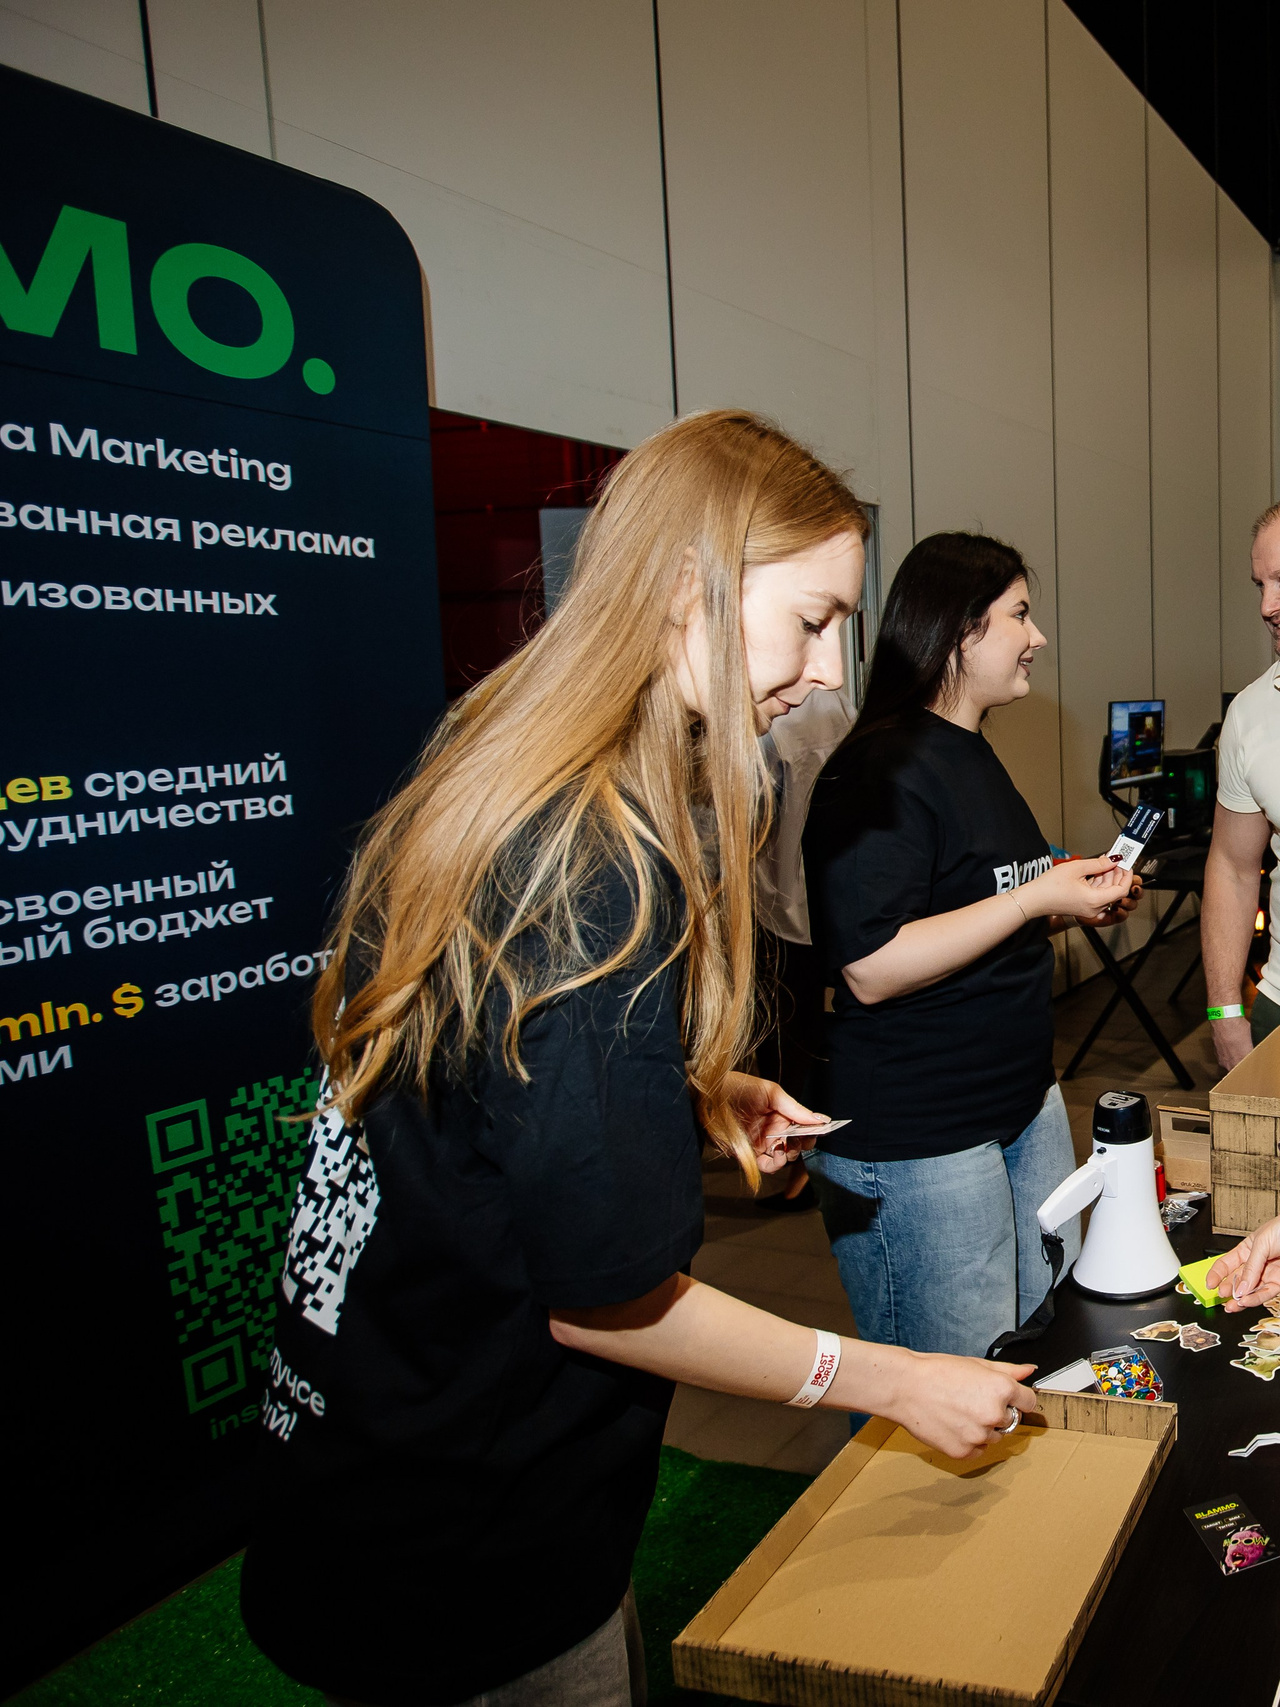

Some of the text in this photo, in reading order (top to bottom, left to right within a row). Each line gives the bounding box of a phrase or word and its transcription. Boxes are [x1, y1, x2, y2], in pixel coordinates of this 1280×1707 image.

[49, 422, 292, 491] Marketing
[192, 519, 376, 559] реклама
[0, 580, 279, 617] изованных
[0, 752, 287, 811] ев средний
[0, 791, 294, 852] удничества
[83, 896, 274, 950] бюджет
[111, 982, 145, 1018] $
[154, 948, 335, 1008] заработ
[810, 1353, 828, 1386] BOOST
[818, 1355, 836, 1387] FORUM
[210, 1398, 262, 1440] ins
